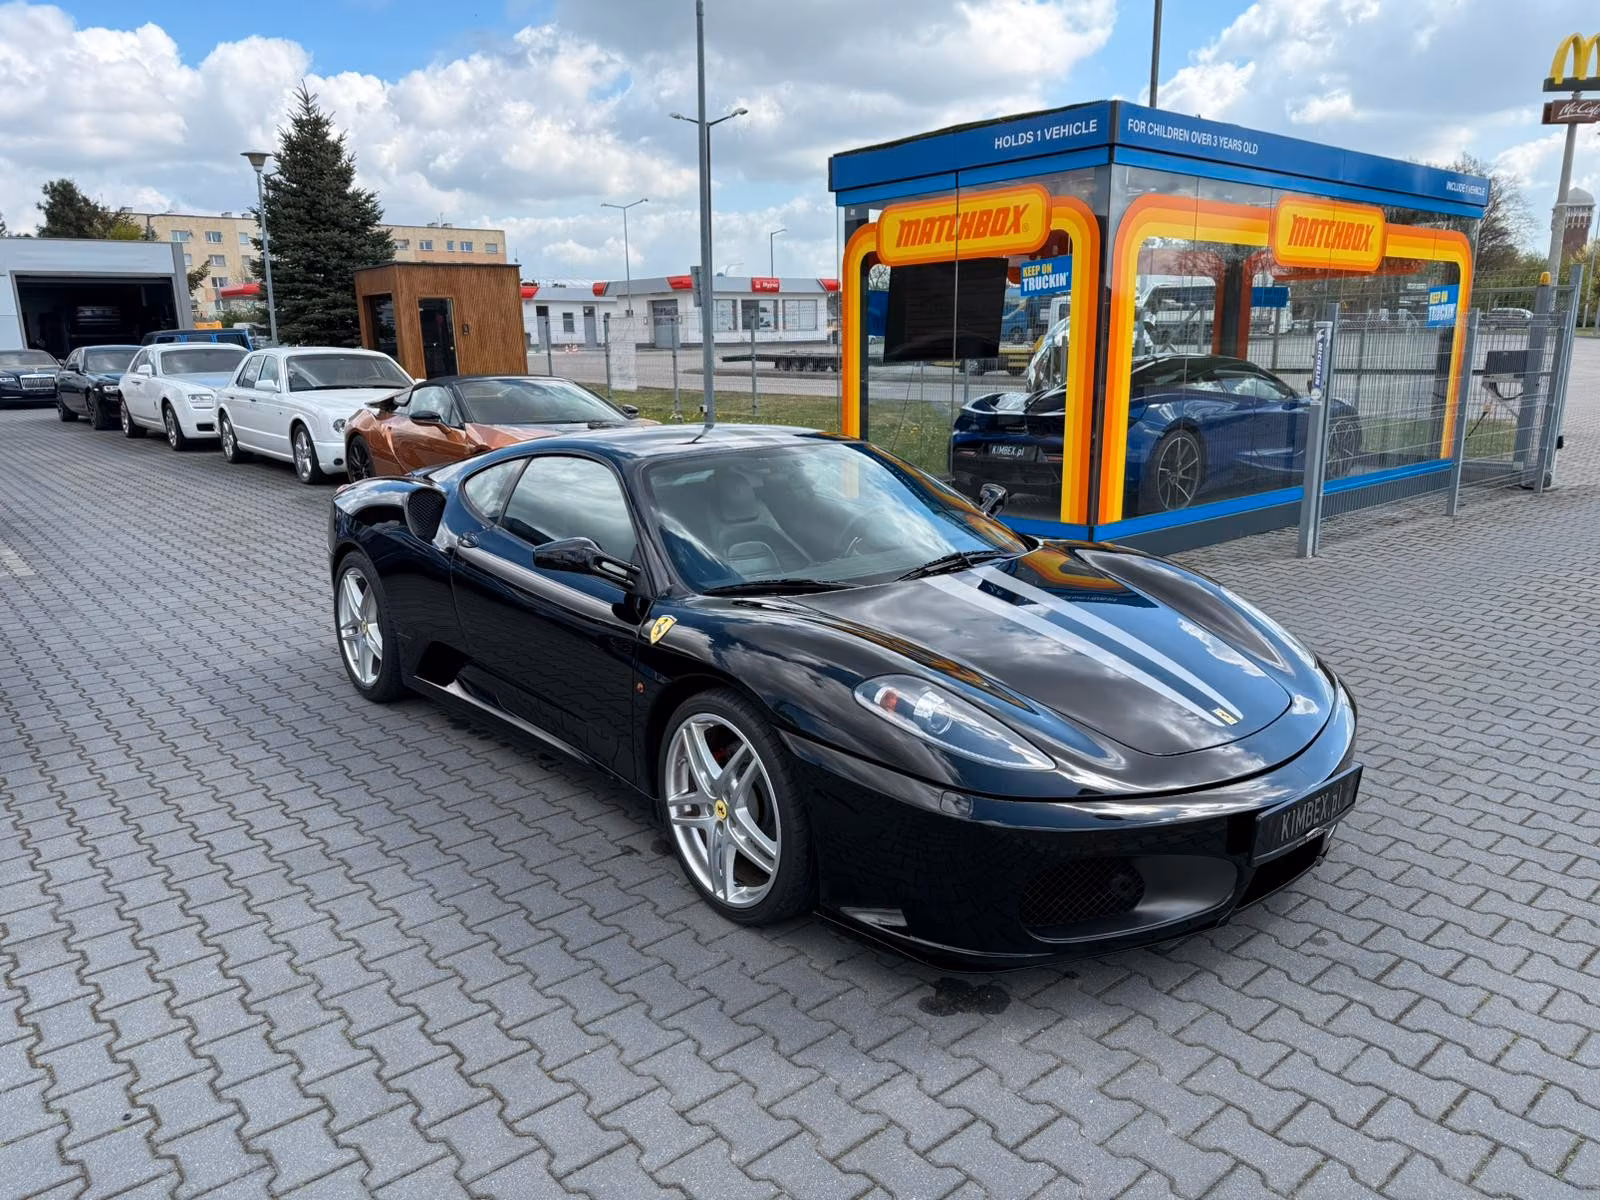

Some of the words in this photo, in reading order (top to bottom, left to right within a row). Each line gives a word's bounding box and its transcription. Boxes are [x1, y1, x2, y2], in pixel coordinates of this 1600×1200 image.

[994, 131, 1034, 150] HOLDS
[1036, 129, 1042, 142] 1
[1044, 119, 1098, 140] VEHICLE
[1127, 118, 1146, 134] FOR
[1147, 122, 1190, 142] CHILDREN
[1190, 131, 1212, 146] OVER
[1212, 135, 1218, 147] 3
[1218, 136, 1243, 152] YEARS
[1243, 141, 1258, 155] OLD
[895, 203, 1029, 248] MATCHBOX
[1288, 214, 1375, 252] MATCHBOX
[1022, 271, 1069, 292] TRUCKIN'
[1023, 264, 1041, 278] KEEP
[1041, 263, 1053, 275] ON
[1314, 342, 1324, 386] MICHELIN
[991, 445, 1025, 458] KIMBEX.pl
[1280, 784, 1343, 842] KIMBEX.pl
